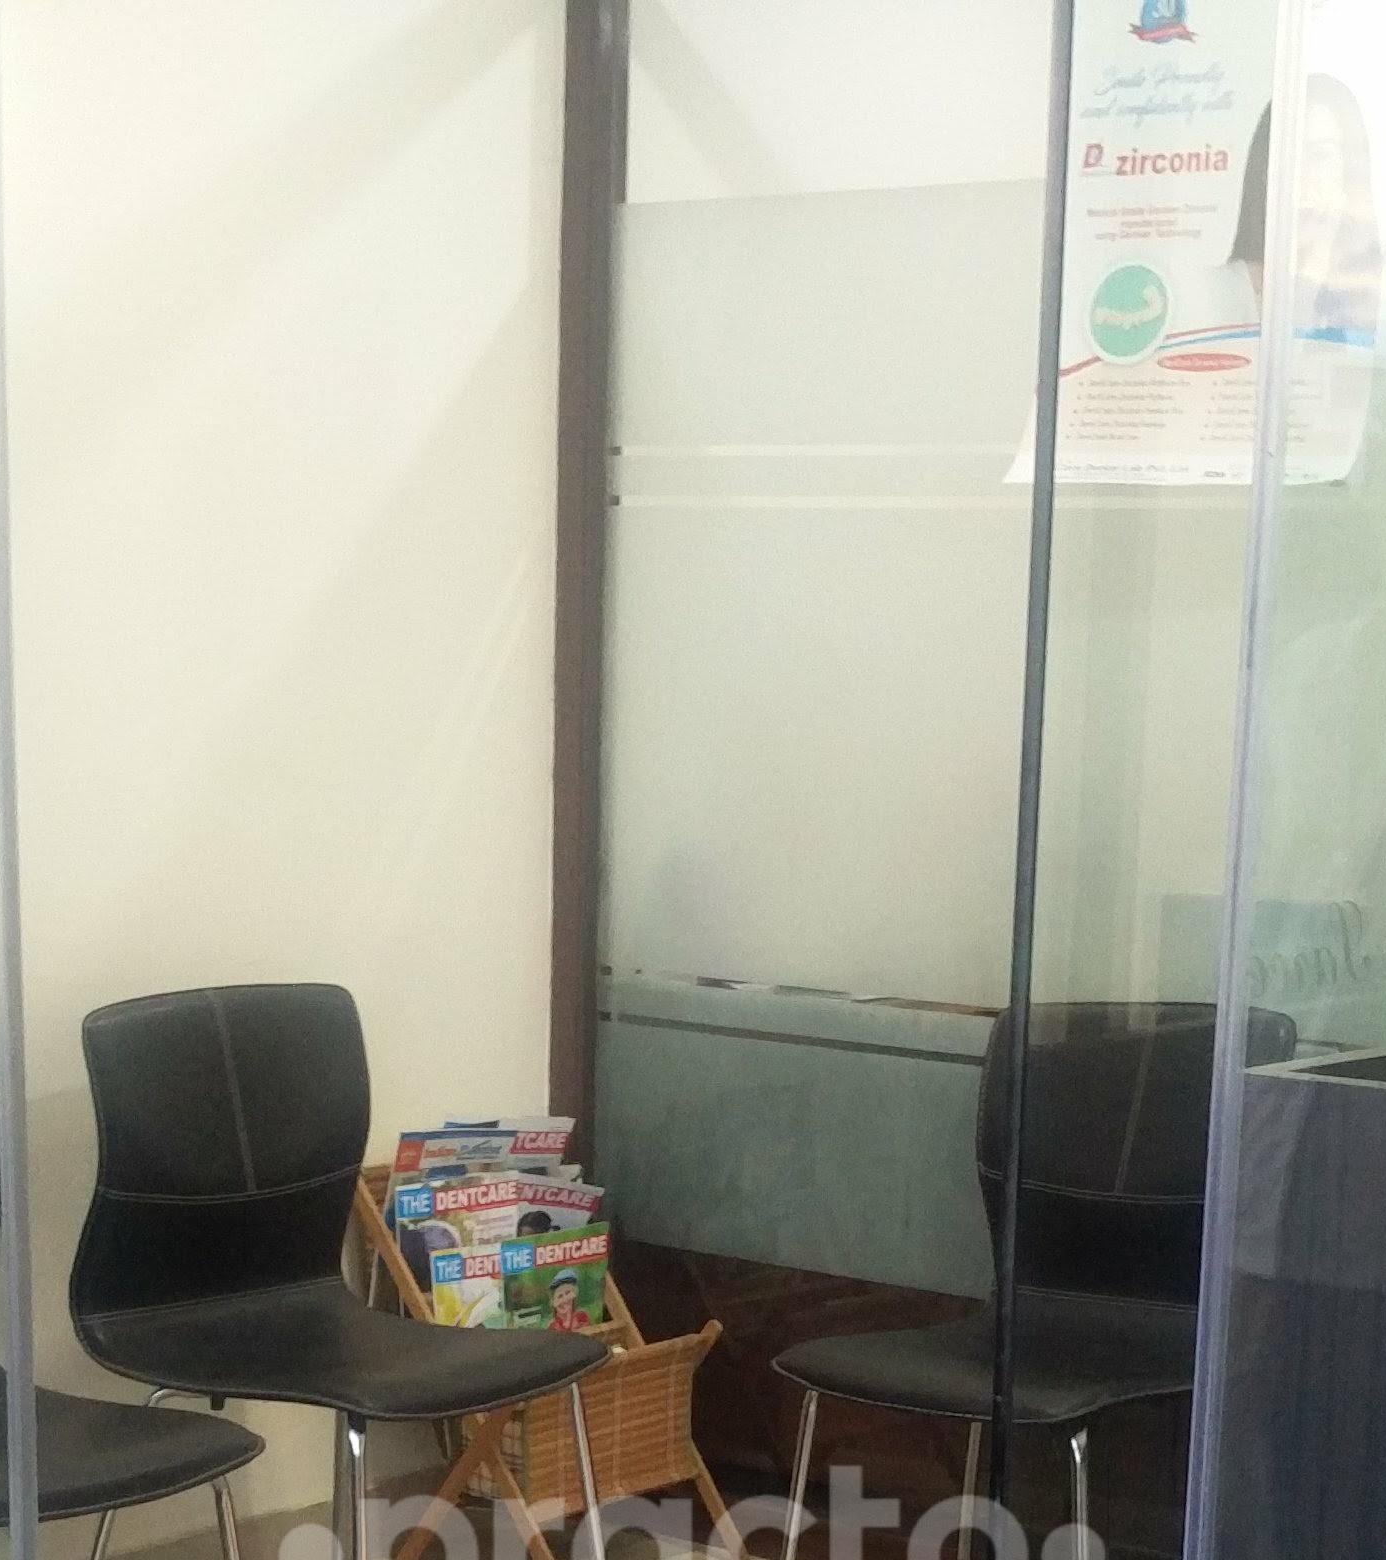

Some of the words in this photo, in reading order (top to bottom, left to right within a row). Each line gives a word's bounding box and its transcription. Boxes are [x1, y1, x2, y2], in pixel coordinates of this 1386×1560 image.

[1116, 143, 1229, 176] zirconia
[515, 1132, 566, 1150] TCARE
[399, 1194, 432, 1215] THE
[434, 1181, 518, 1212] DENTCARE
[521, 1188, 597, 1208] NTCARE
[503, 1249, 533, 1271] THE
[535, 1234, 608, 1267] DENTCARE
[436, 1261, 463, 1282] THE
[465, 1255, 501, 1277] DENT
